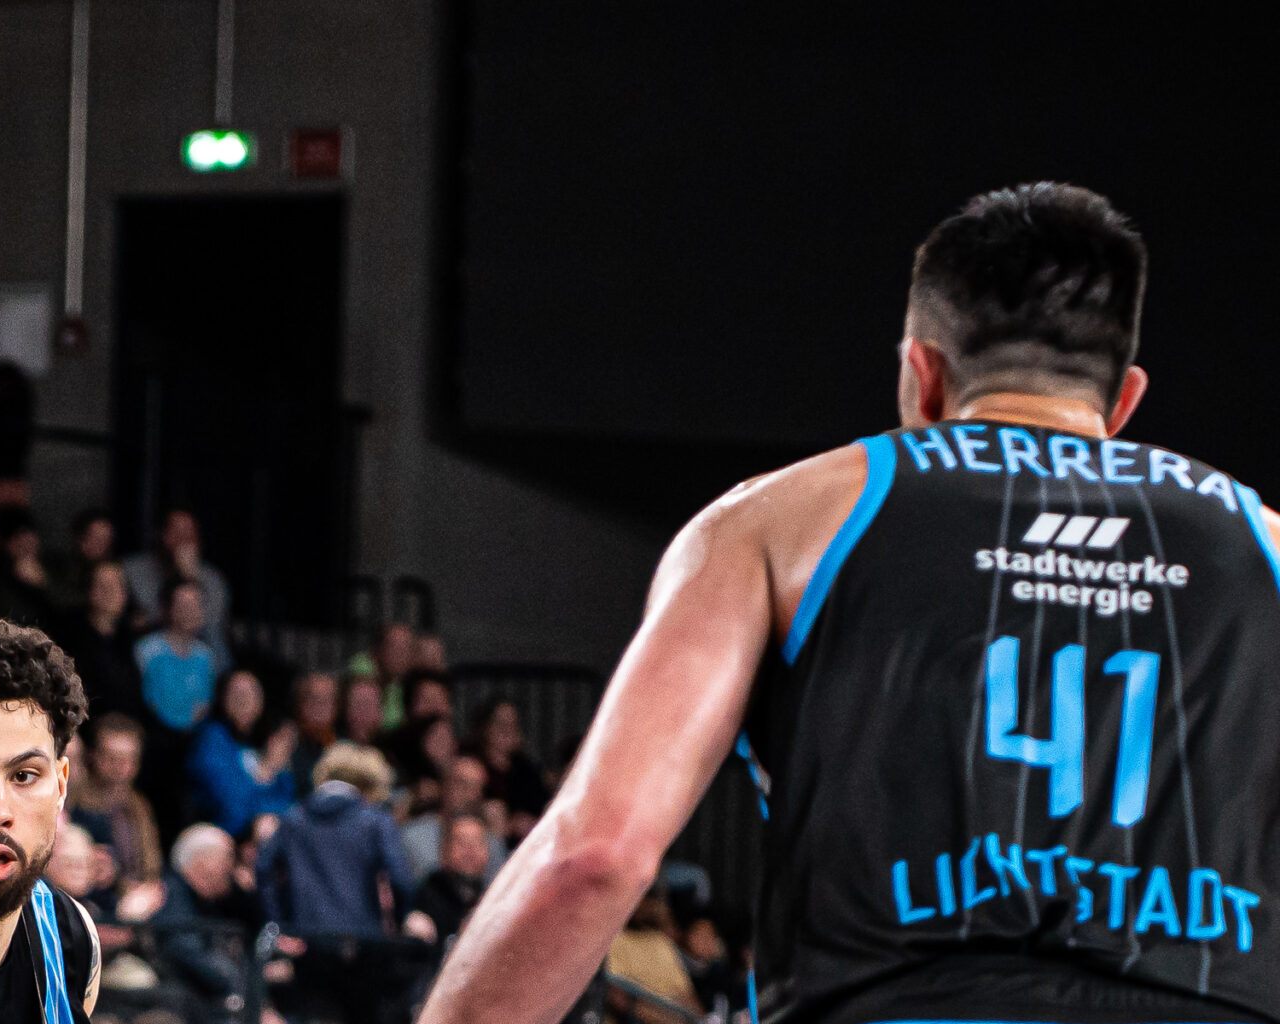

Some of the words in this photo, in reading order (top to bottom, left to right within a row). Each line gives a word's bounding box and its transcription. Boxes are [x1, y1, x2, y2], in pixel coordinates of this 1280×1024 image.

[900, 424, 1239, 514] HERRERA
[975, 547, 1190, 587] stadtwerke
[1011, 579, 1154, 617] energie
[986, 636, 1161, 828] 41
